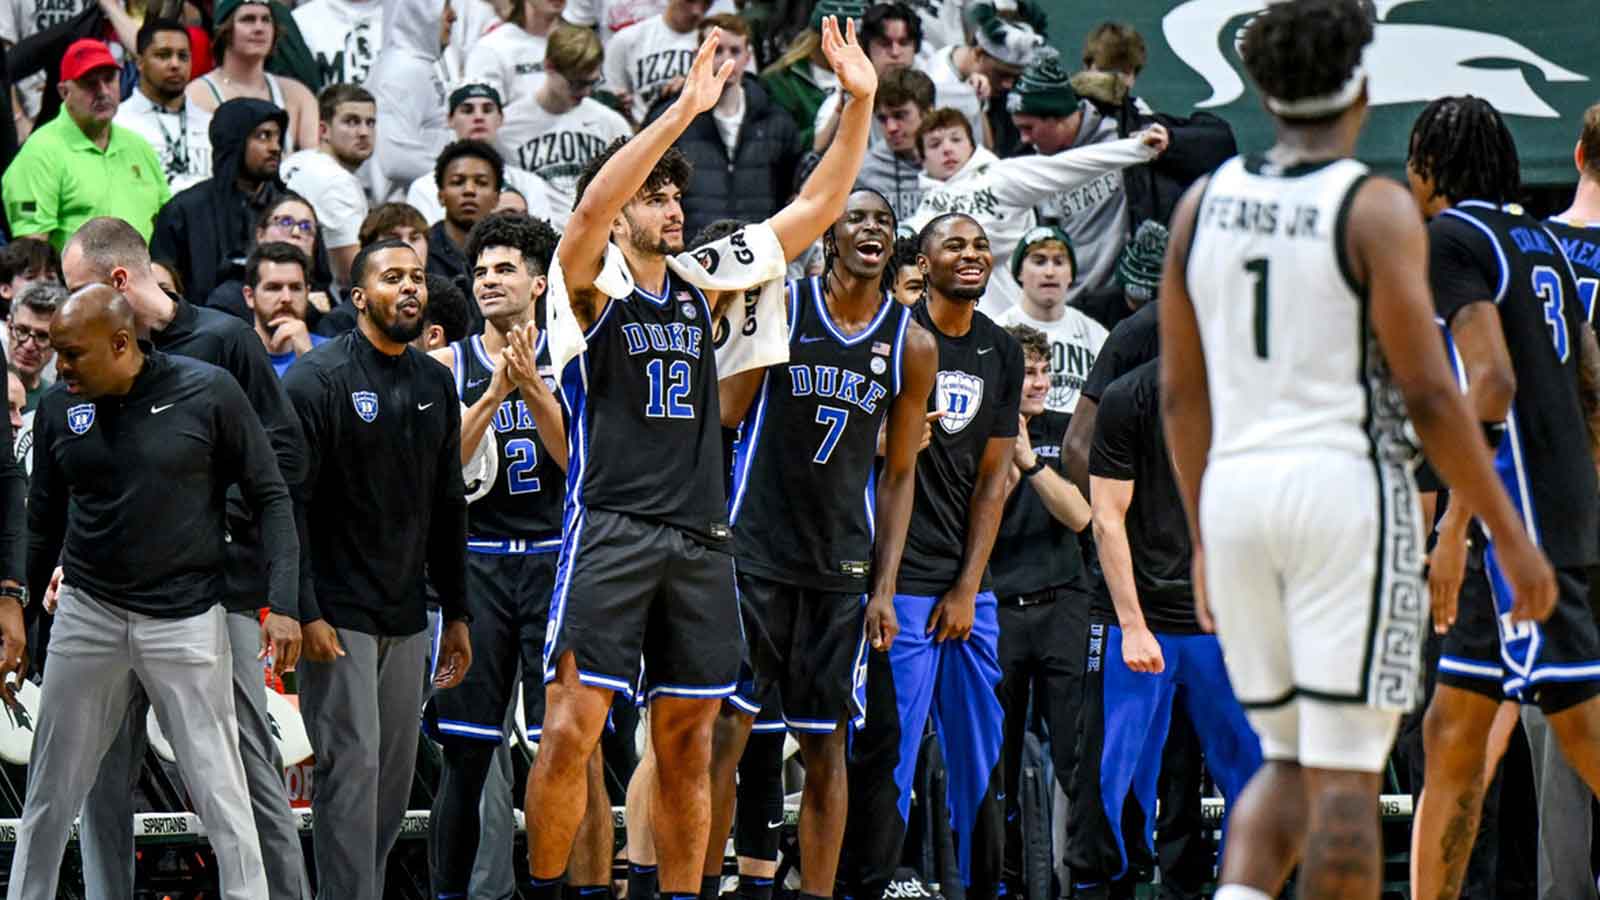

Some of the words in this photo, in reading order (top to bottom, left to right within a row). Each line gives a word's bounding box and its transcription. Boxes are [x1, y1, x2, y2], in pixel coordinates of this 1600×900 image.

[1204, 198, 1279, 236] FEARS
[1242, 256, 1270, 362] 1
[1530, 265, 1570, 365] 3
[622, 322, 703, 359] DUKE
[646, 358, 695, 419] 12
[788, 364, 887, 415] DUKE
[813, 404, 849, 465] 7
[504, 438, 541, 495] 2
[142, 816, 188, 834] SPARTANS
